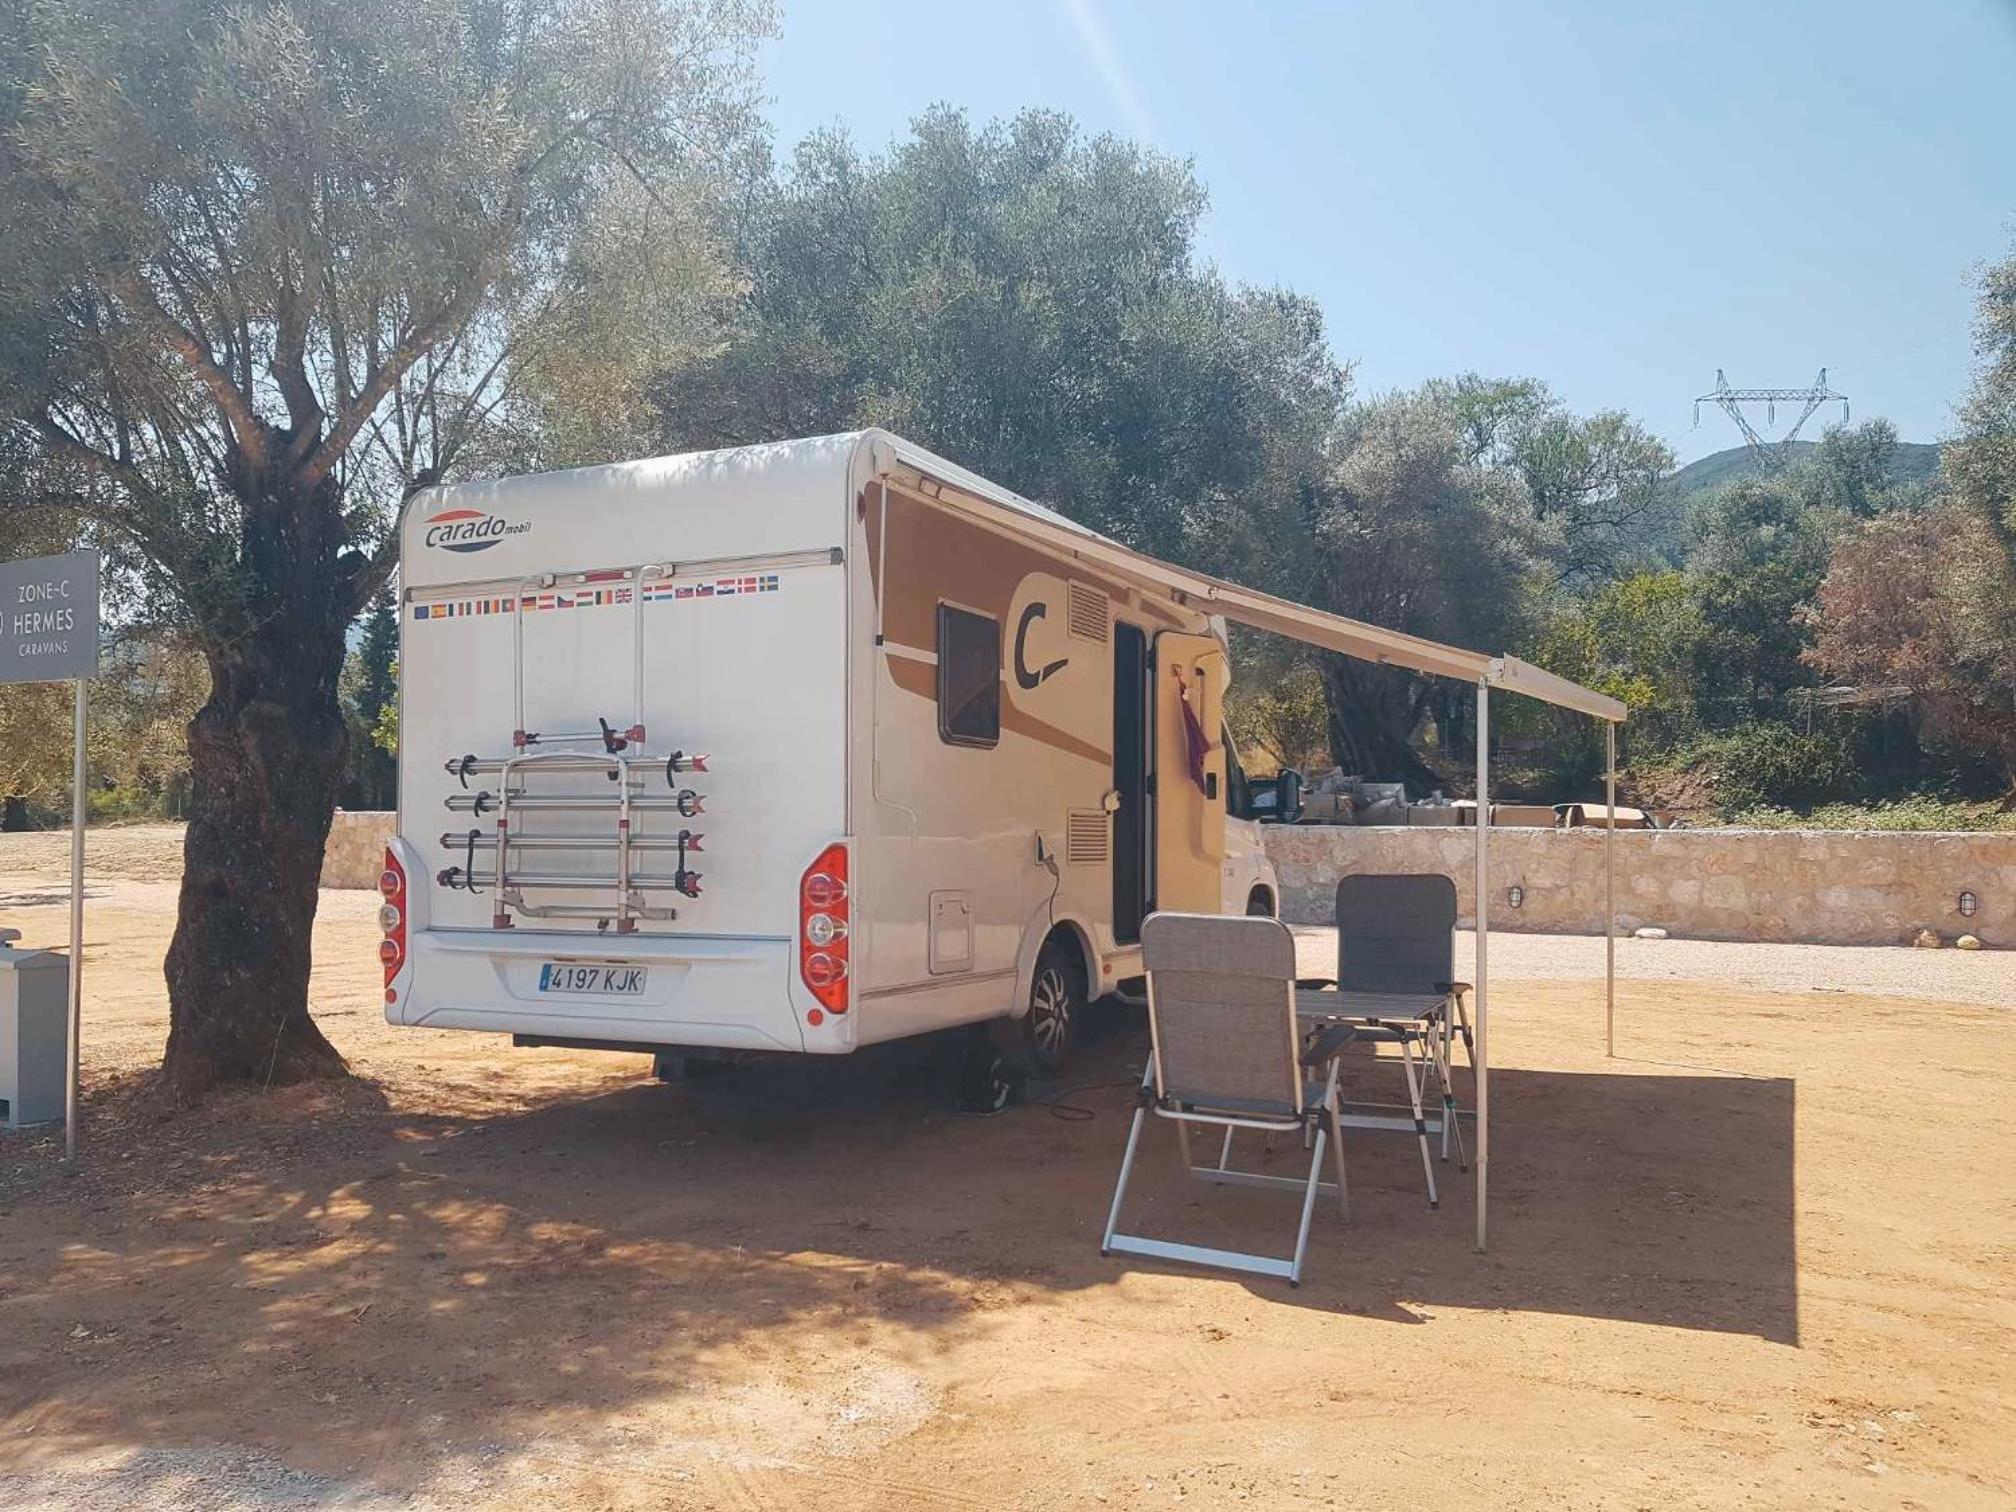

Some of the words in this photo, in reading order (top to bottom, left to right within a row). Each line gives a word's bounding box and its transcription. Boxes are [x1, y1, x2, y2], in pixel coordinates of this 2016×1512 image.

[425, 515, 506, 547] carado
[504, 522, 531, 534] mobil
[18, 580, 70, 603] ZONE-C
[14, 608, 74, 635] HERMES
[19, 640, 69, 657] CARAVANS
[552, 968, 599, 990] 4197
[603, 969, 641, 992] KJK
